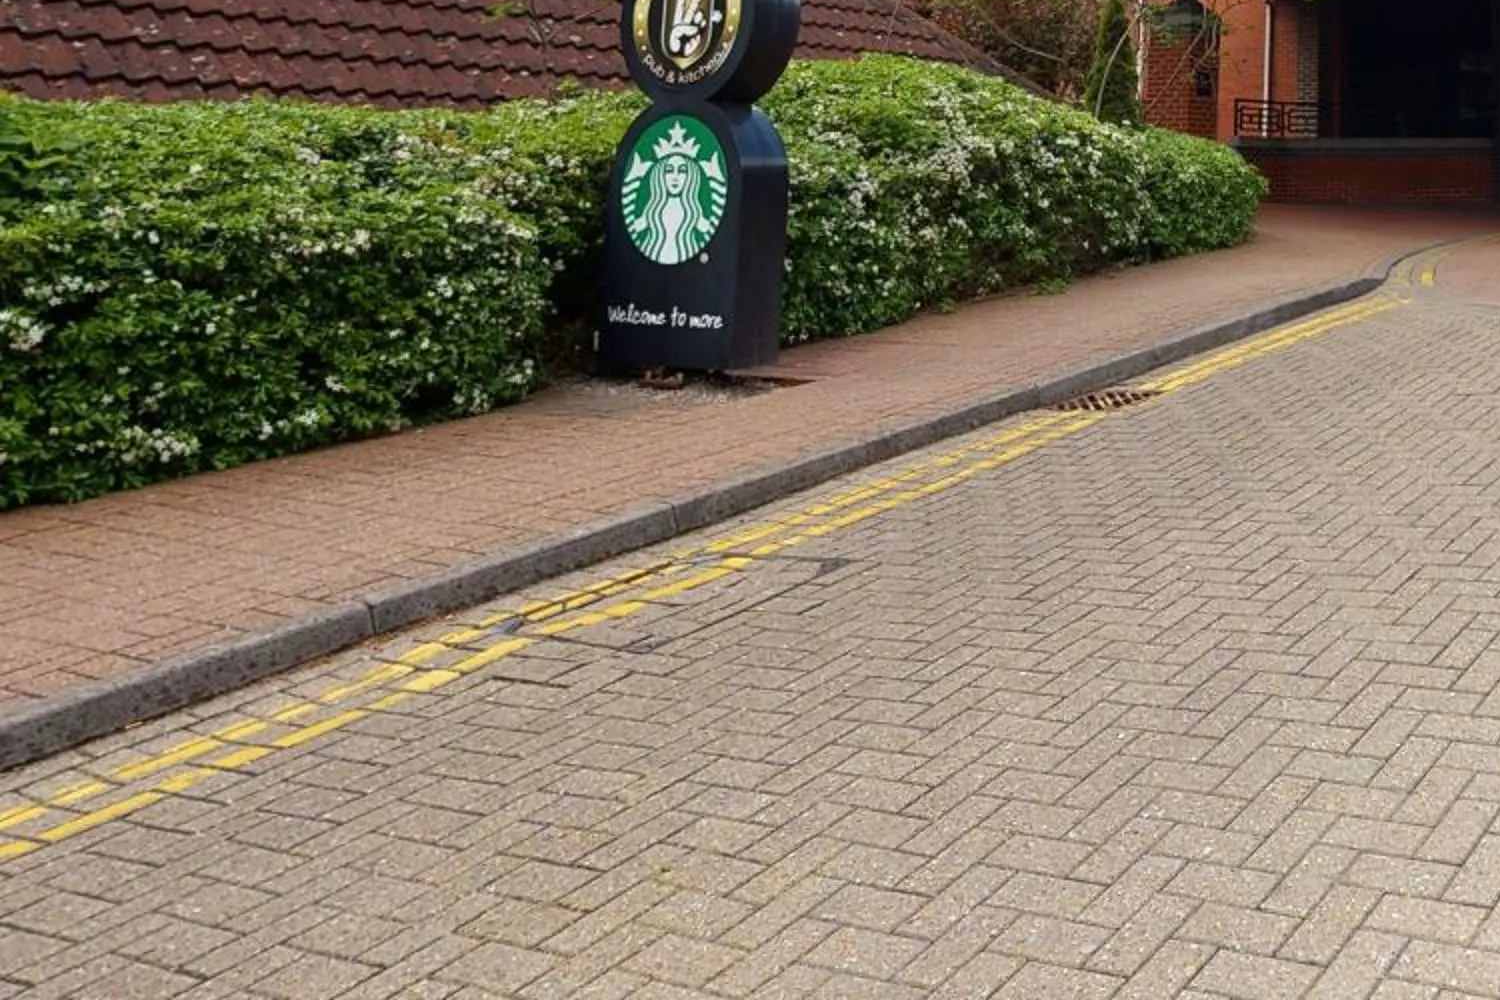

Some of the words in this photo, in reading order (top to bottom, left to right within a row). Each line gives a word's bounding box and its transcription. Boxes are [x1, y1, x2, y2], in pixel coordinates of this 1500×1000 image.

[607, 302, 667, 326] Welcome
[670, 305, 687, 328] to
[689, 313, 724, 329] more
